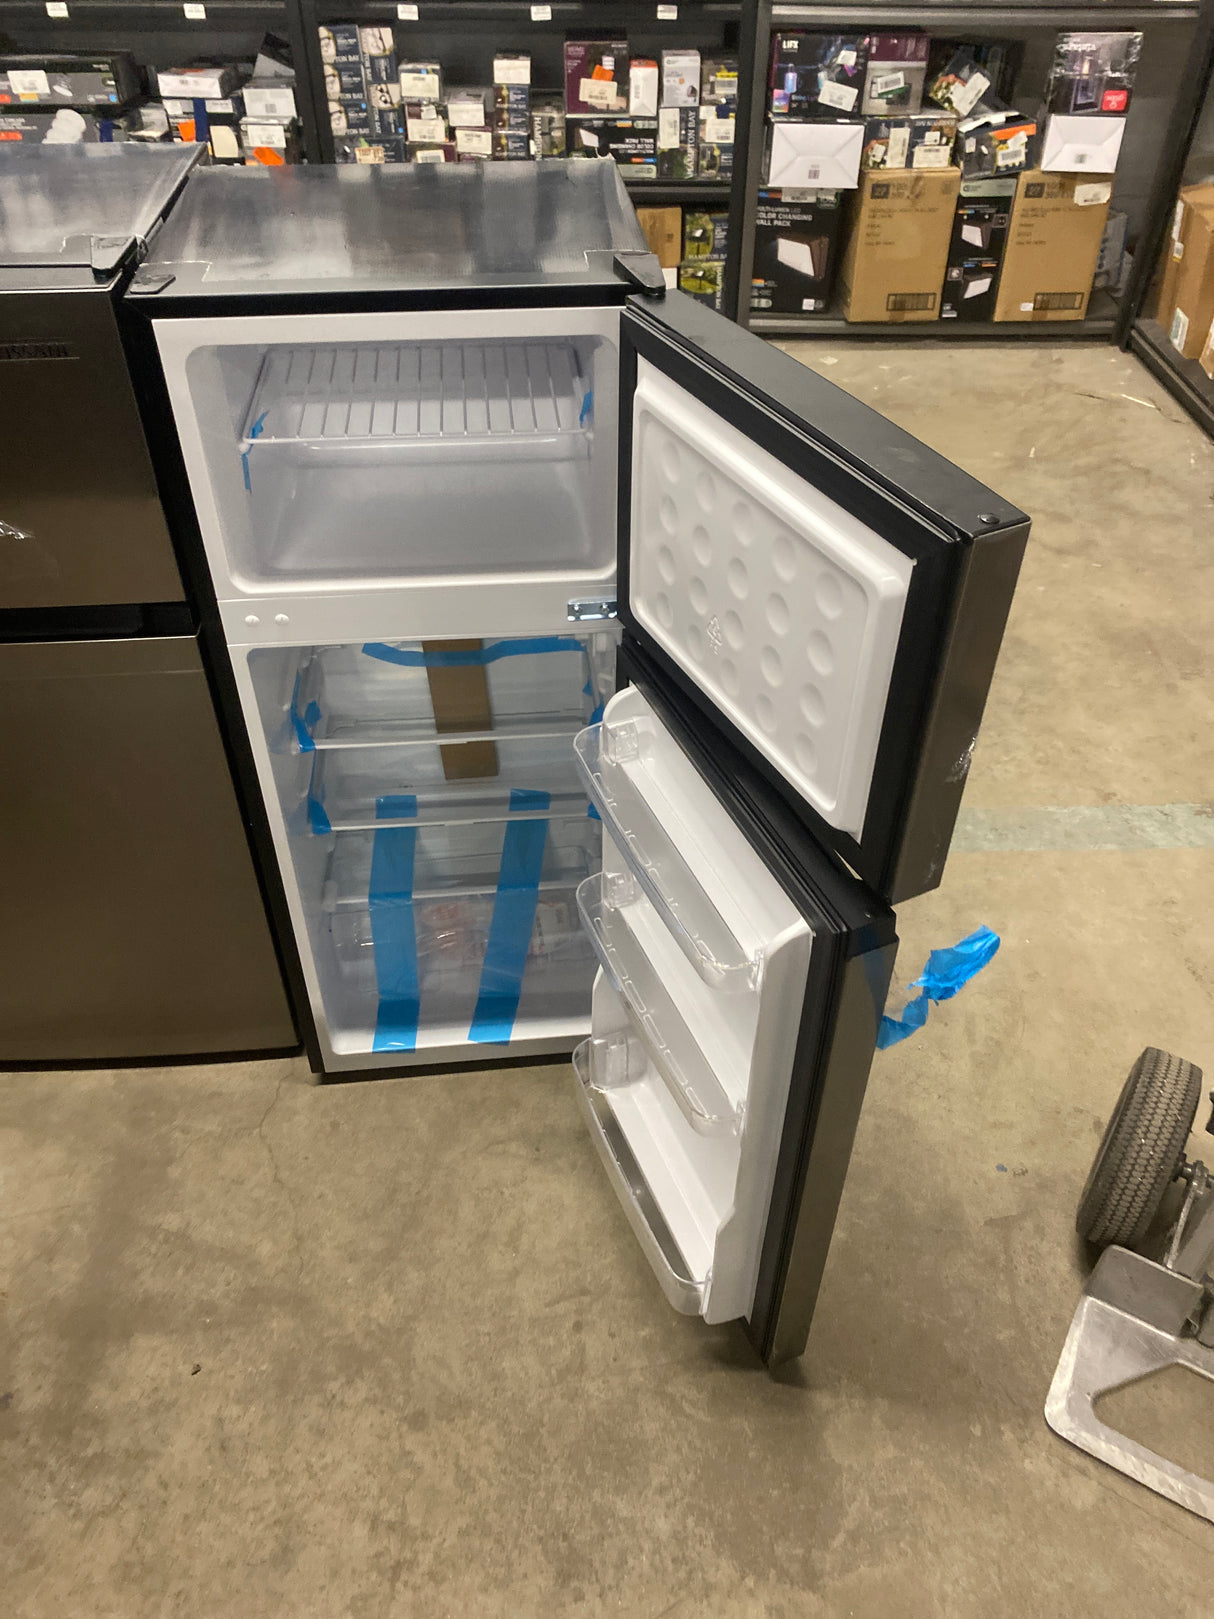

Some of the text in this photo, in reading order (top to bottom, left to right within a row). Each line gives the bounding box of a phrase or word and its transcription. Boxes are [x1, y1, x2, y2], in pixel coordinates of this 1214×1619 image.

[783, 40, 798, 49] LIFX
[688, 111, 696, 128] BAY
[778, 213, 812, 221] CHANGING
